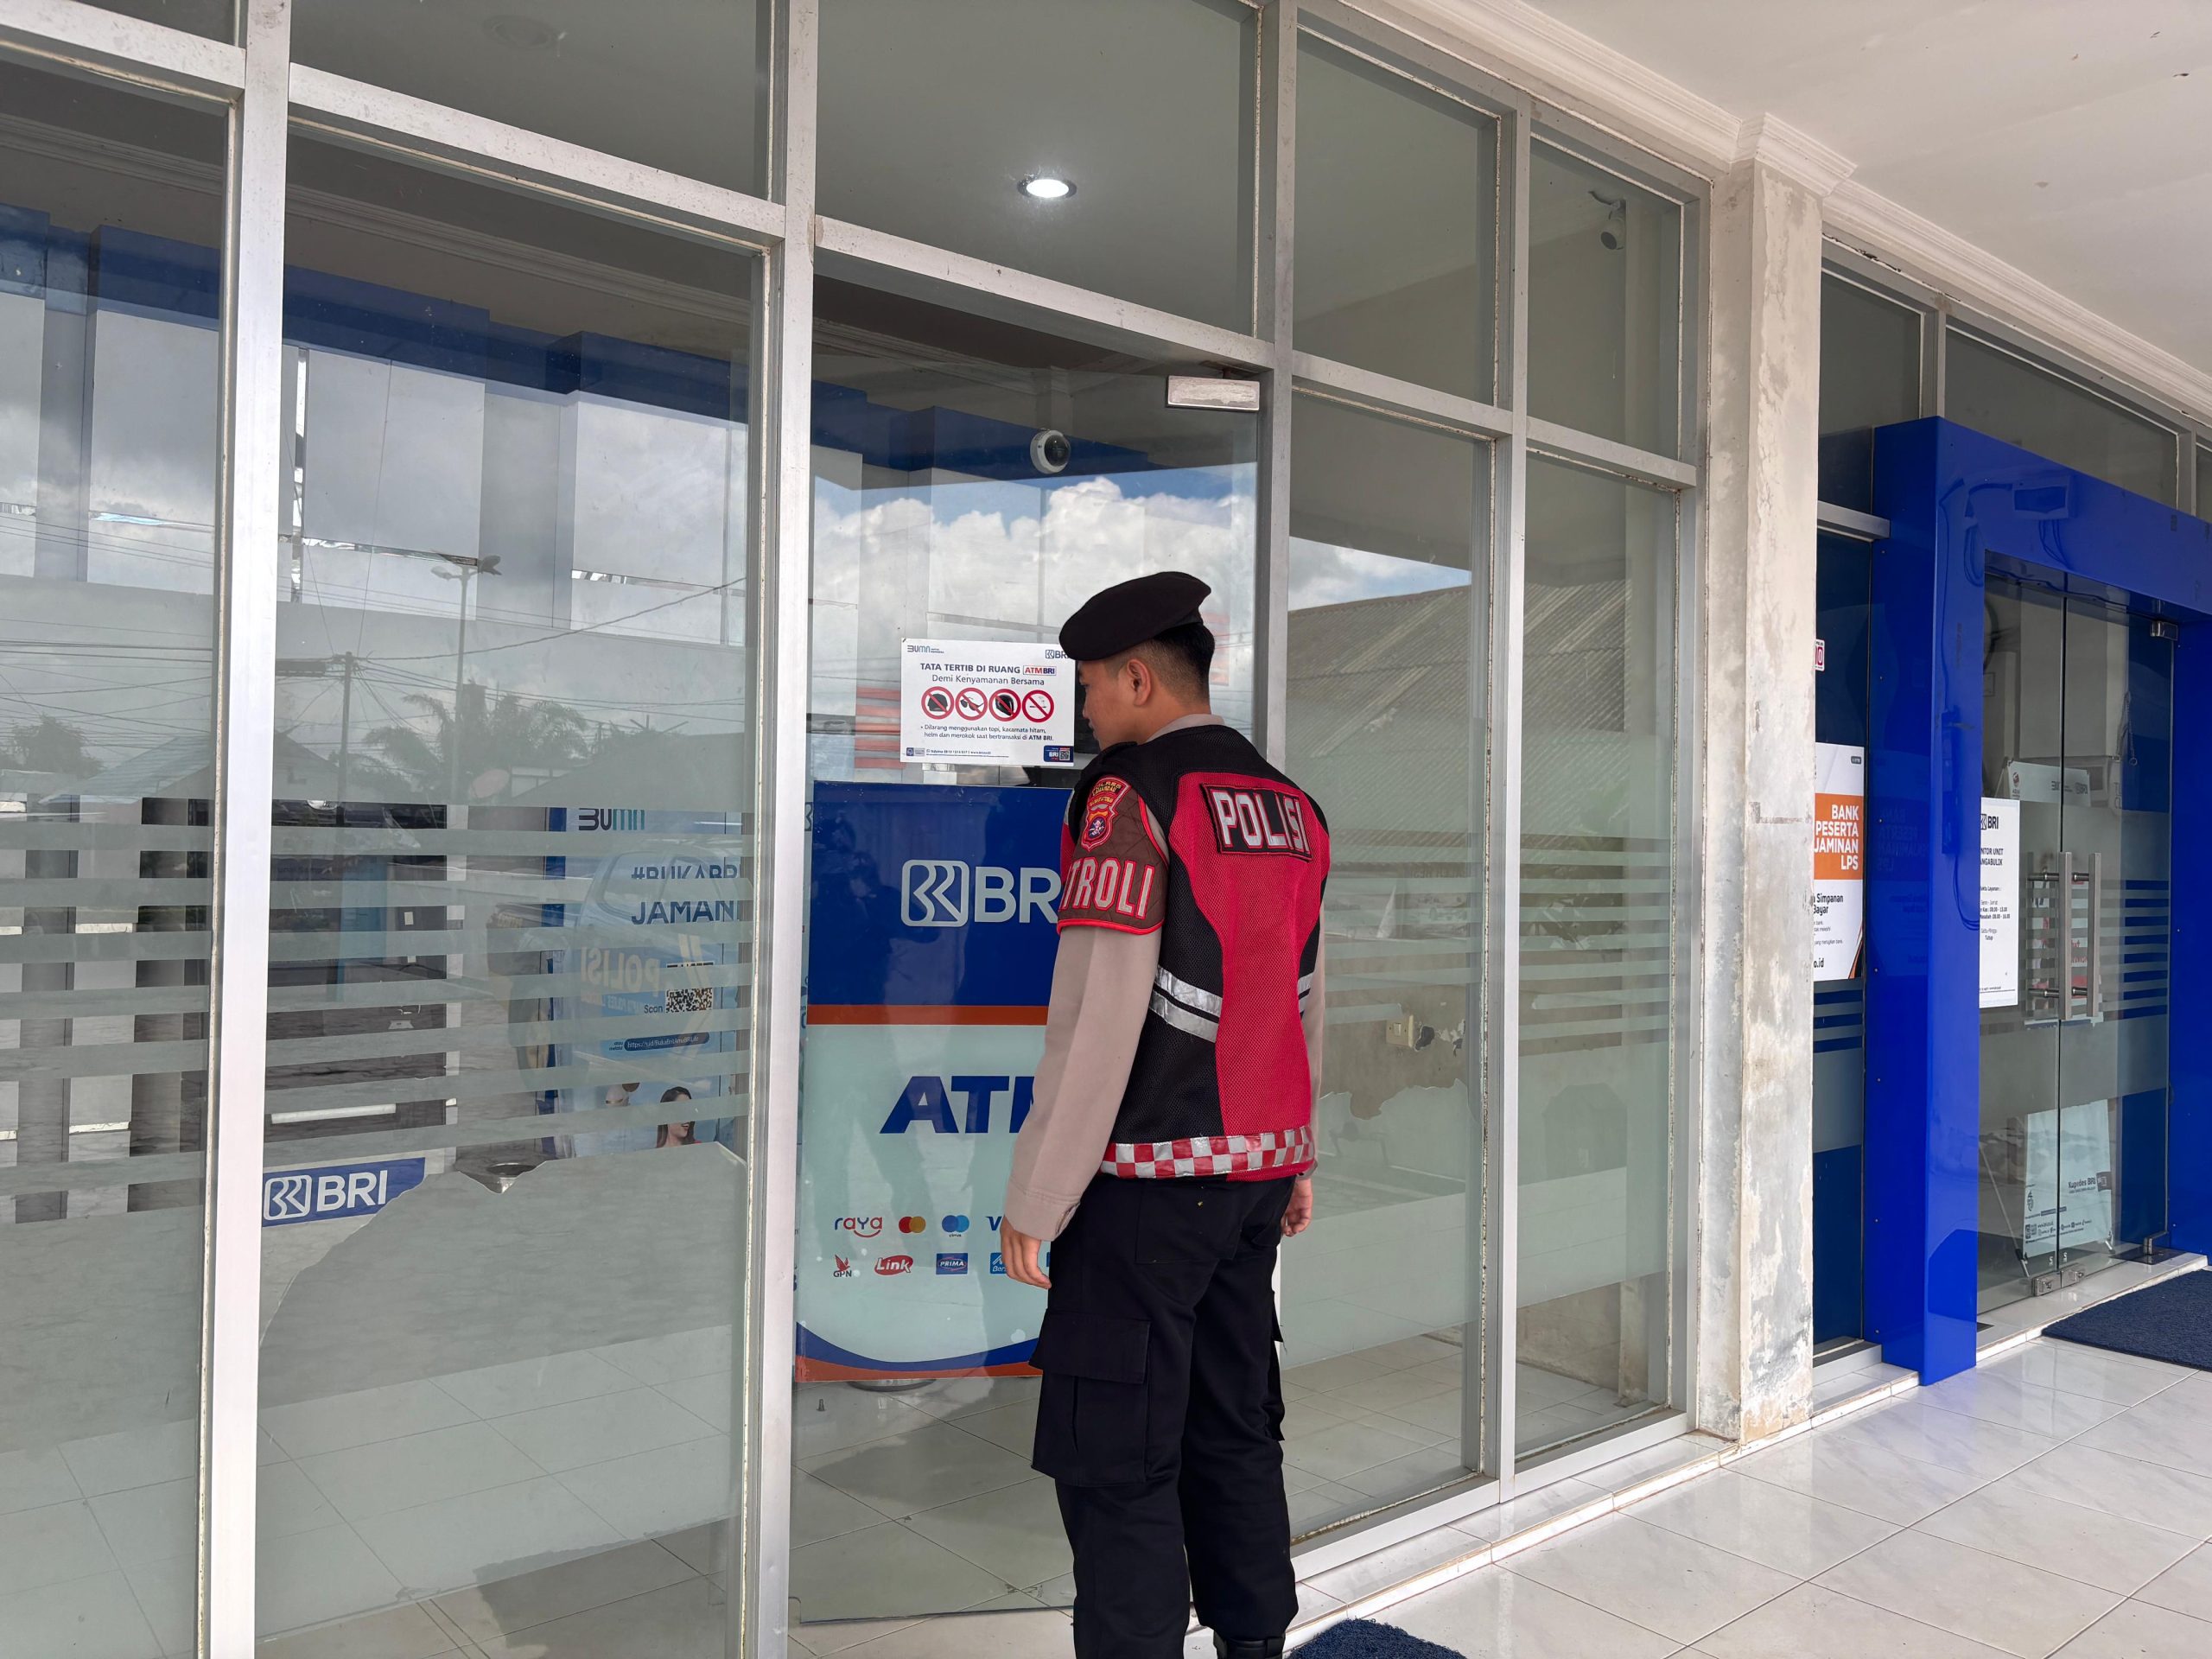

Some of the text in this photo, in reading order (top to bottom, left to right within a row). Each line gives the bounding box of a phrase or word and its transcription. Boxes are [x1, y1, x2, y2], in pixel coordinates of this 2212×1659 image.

[931, 674, 1045, 685] Demi Kenyamanan Bersama
[1831, 804, 1859, 820] BANK
[1211, 790, 1310, 854] POLISI
[1815, 820, 1859, 837] PESERTA
[1987, 816, 1999, 830] BRI
[1840, 855, 1859, 870] LPS
[1816, 893, 1844, 905] Simpanan
[644, 1004, 664, 1014] Scan
[316, 1169, 388, 1212] BRI
[834, 1217, 883, 1230] raya
[876, 1257, 912, 1273] Link
